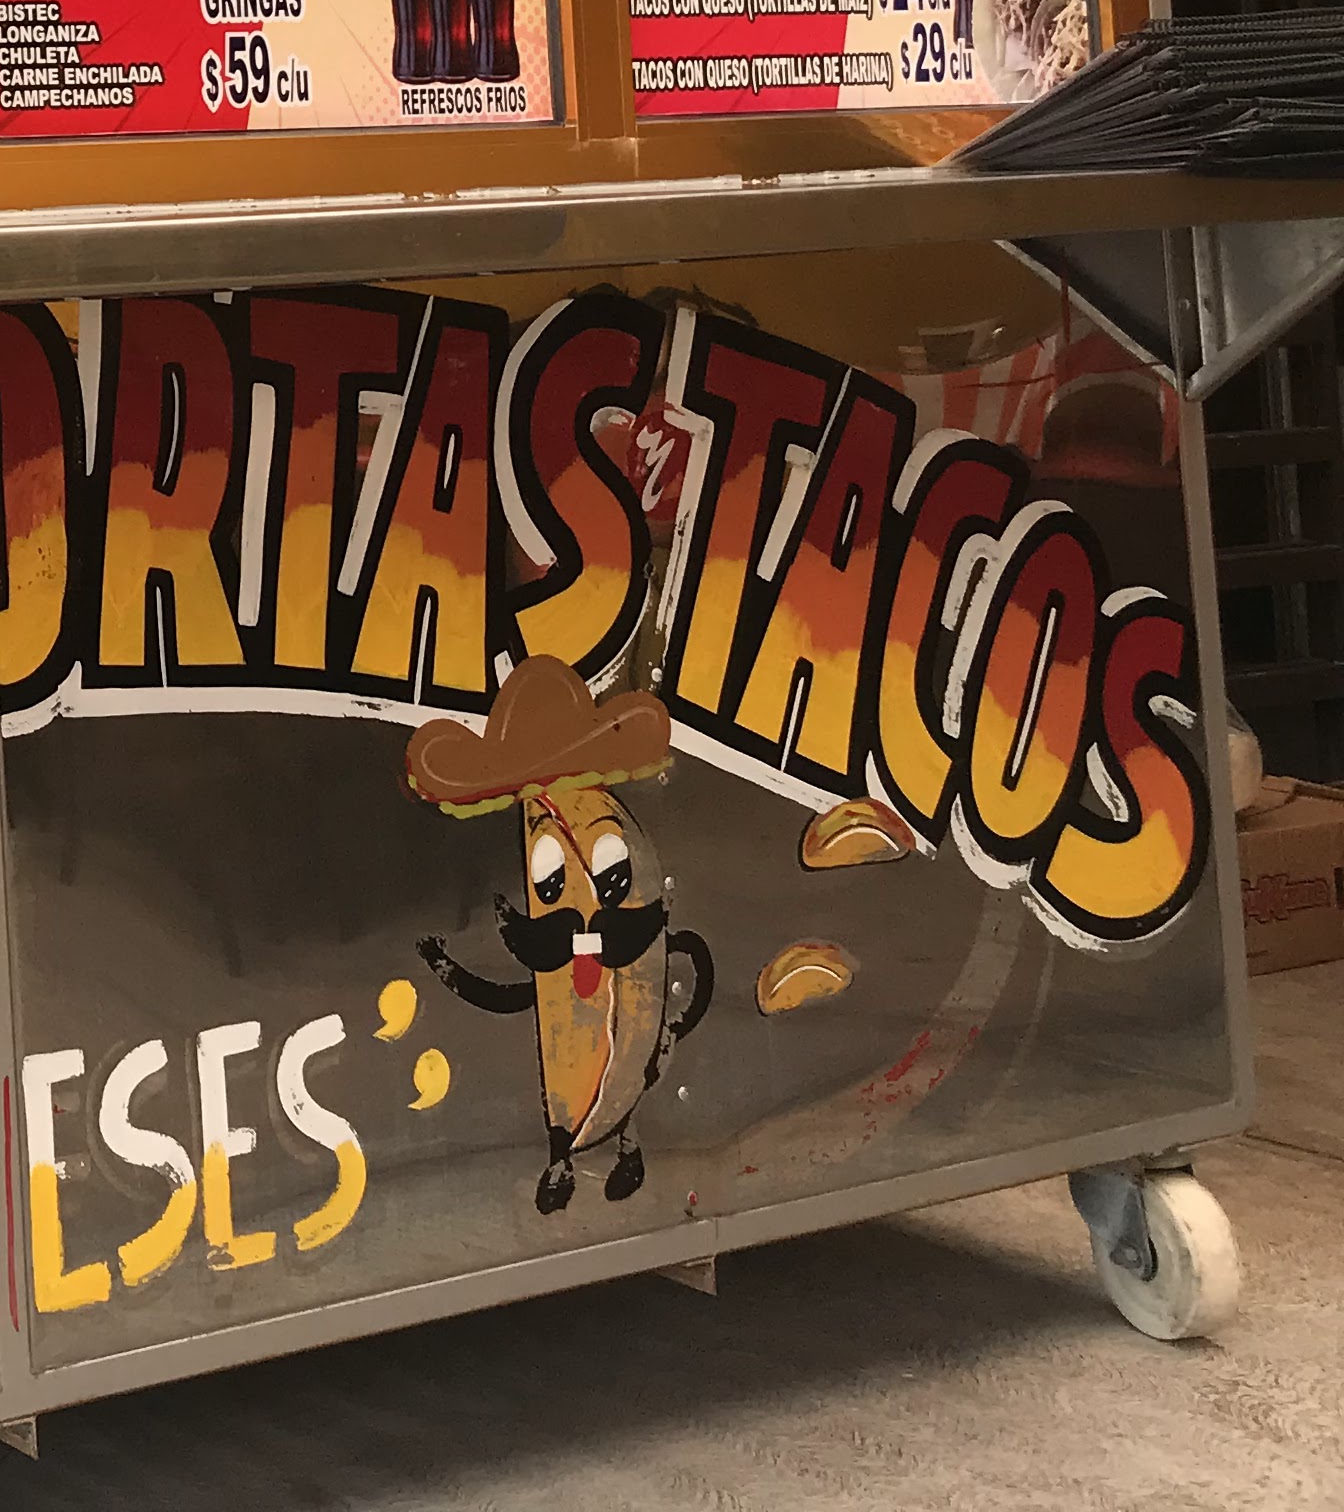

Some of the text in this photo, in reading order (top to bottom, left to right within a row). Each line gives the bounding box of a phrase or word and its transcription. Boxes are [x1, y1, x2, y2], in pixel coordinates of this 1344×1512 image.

[0, 65, 164, 86] CARNE ENCHILADA
[632, 61, 674, 89] TACOS
[677, 60, 703, 88] CON
[706, 59, 749, 88] QUESO
[824, 56, 840, 83] DE
[950, 43, 972, 80] c/u
[276, 58, 310, 102] c/u
[0, 87, 134, 108] CAMPECHANOS
[401, 86, 527, 115] REFRESCOS FRIOS
[667, 306, 1210, 943] TACOS
